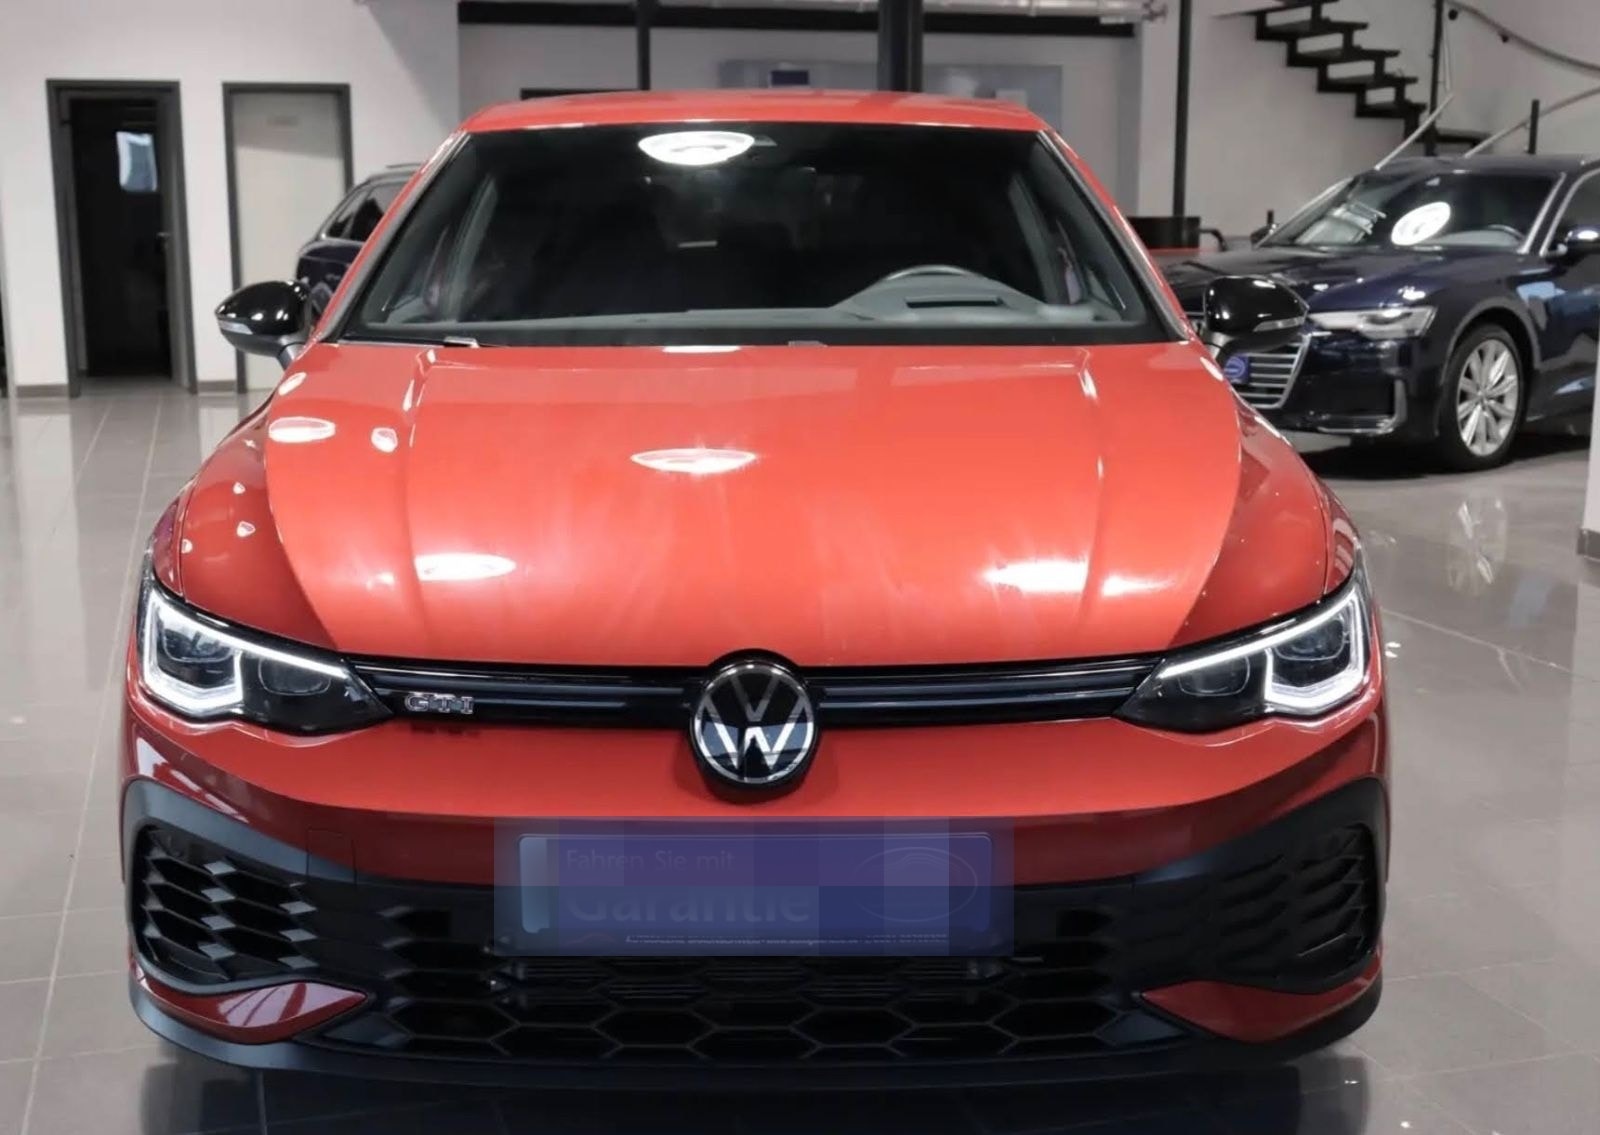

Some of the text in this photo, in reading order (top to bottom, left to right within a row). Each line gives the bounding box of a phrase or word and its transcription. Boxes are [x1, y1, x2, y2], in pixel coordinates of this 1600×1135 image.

[404, 691, 473, 714] GTI
[566, 849, 736, 871] Fahren Sie mit
